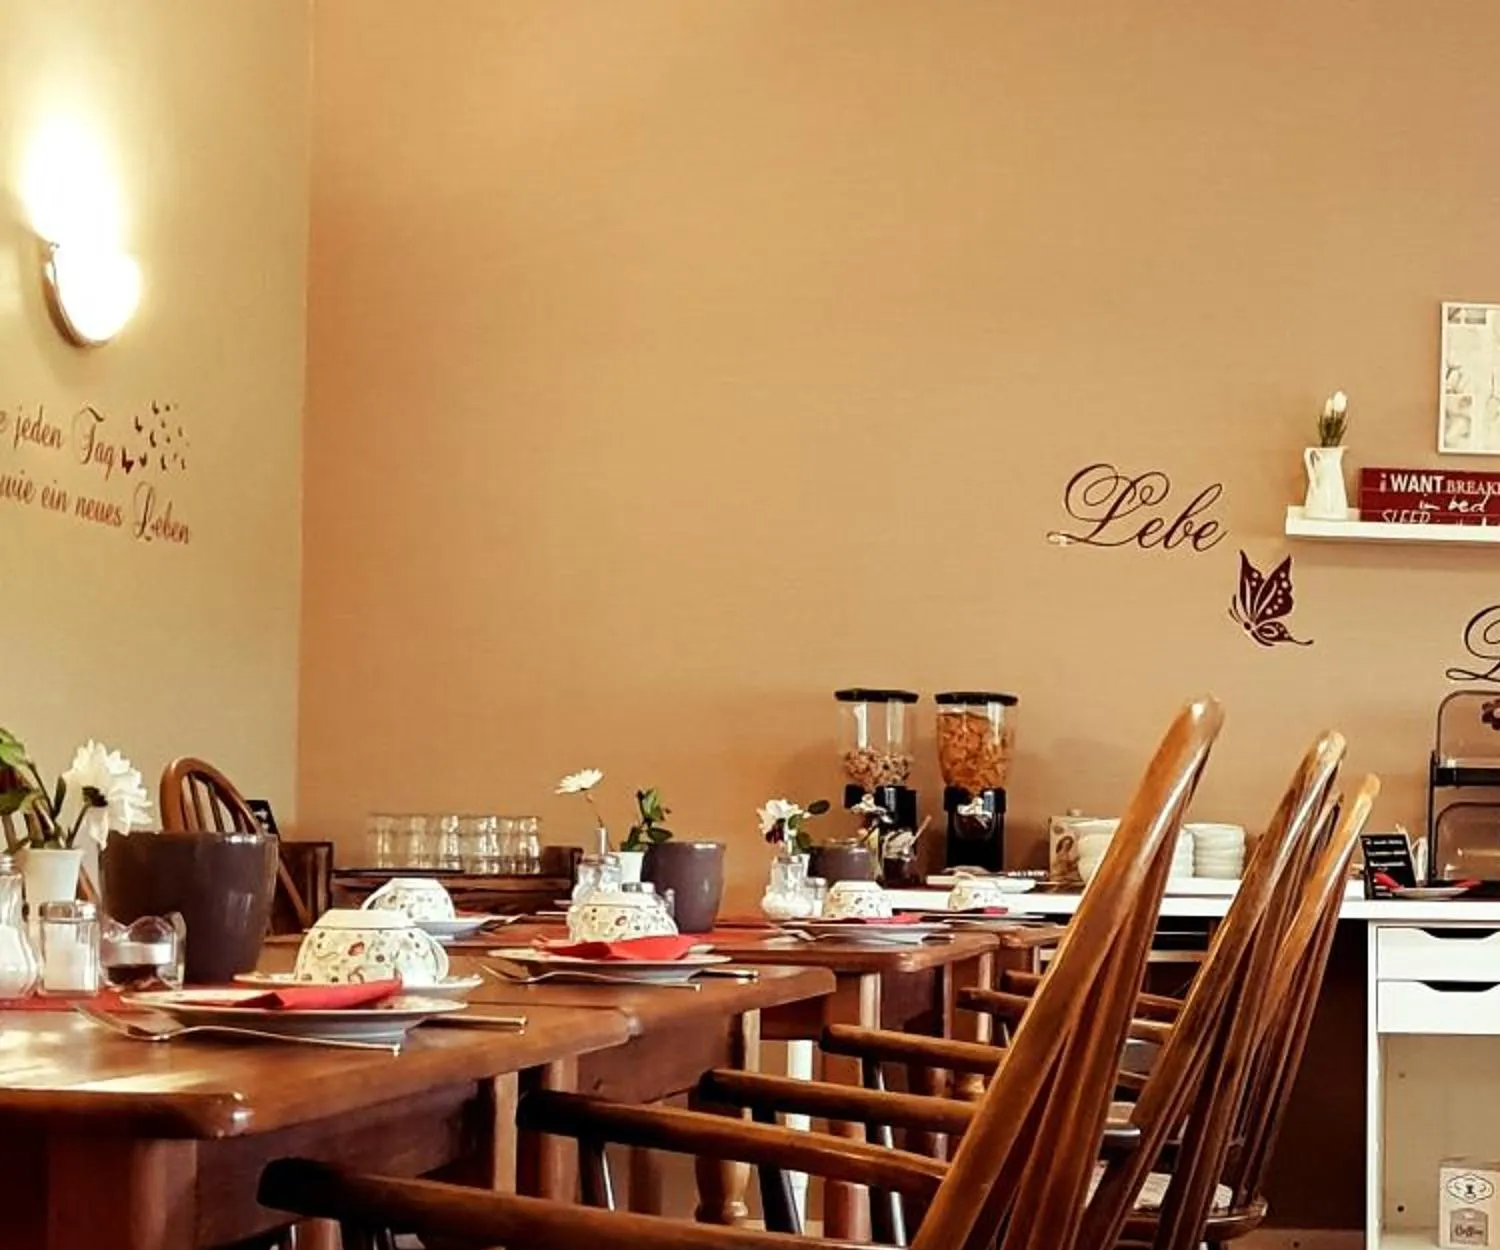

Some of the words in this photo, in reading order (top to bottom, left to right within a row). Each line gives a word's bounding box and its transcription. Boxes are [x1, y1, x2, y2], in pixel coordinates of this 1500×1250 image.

[13, 404, 62, 449] jeden
[72, 406, 114, 481] Tag
[41, 479, 67, 513] ein
[75, 496, 122, 528] neues
[134, 481, 190, 544] Leben
[1047, 463, 1229, 552] Lebe
[1390, 473, 1445, 494] WANT
